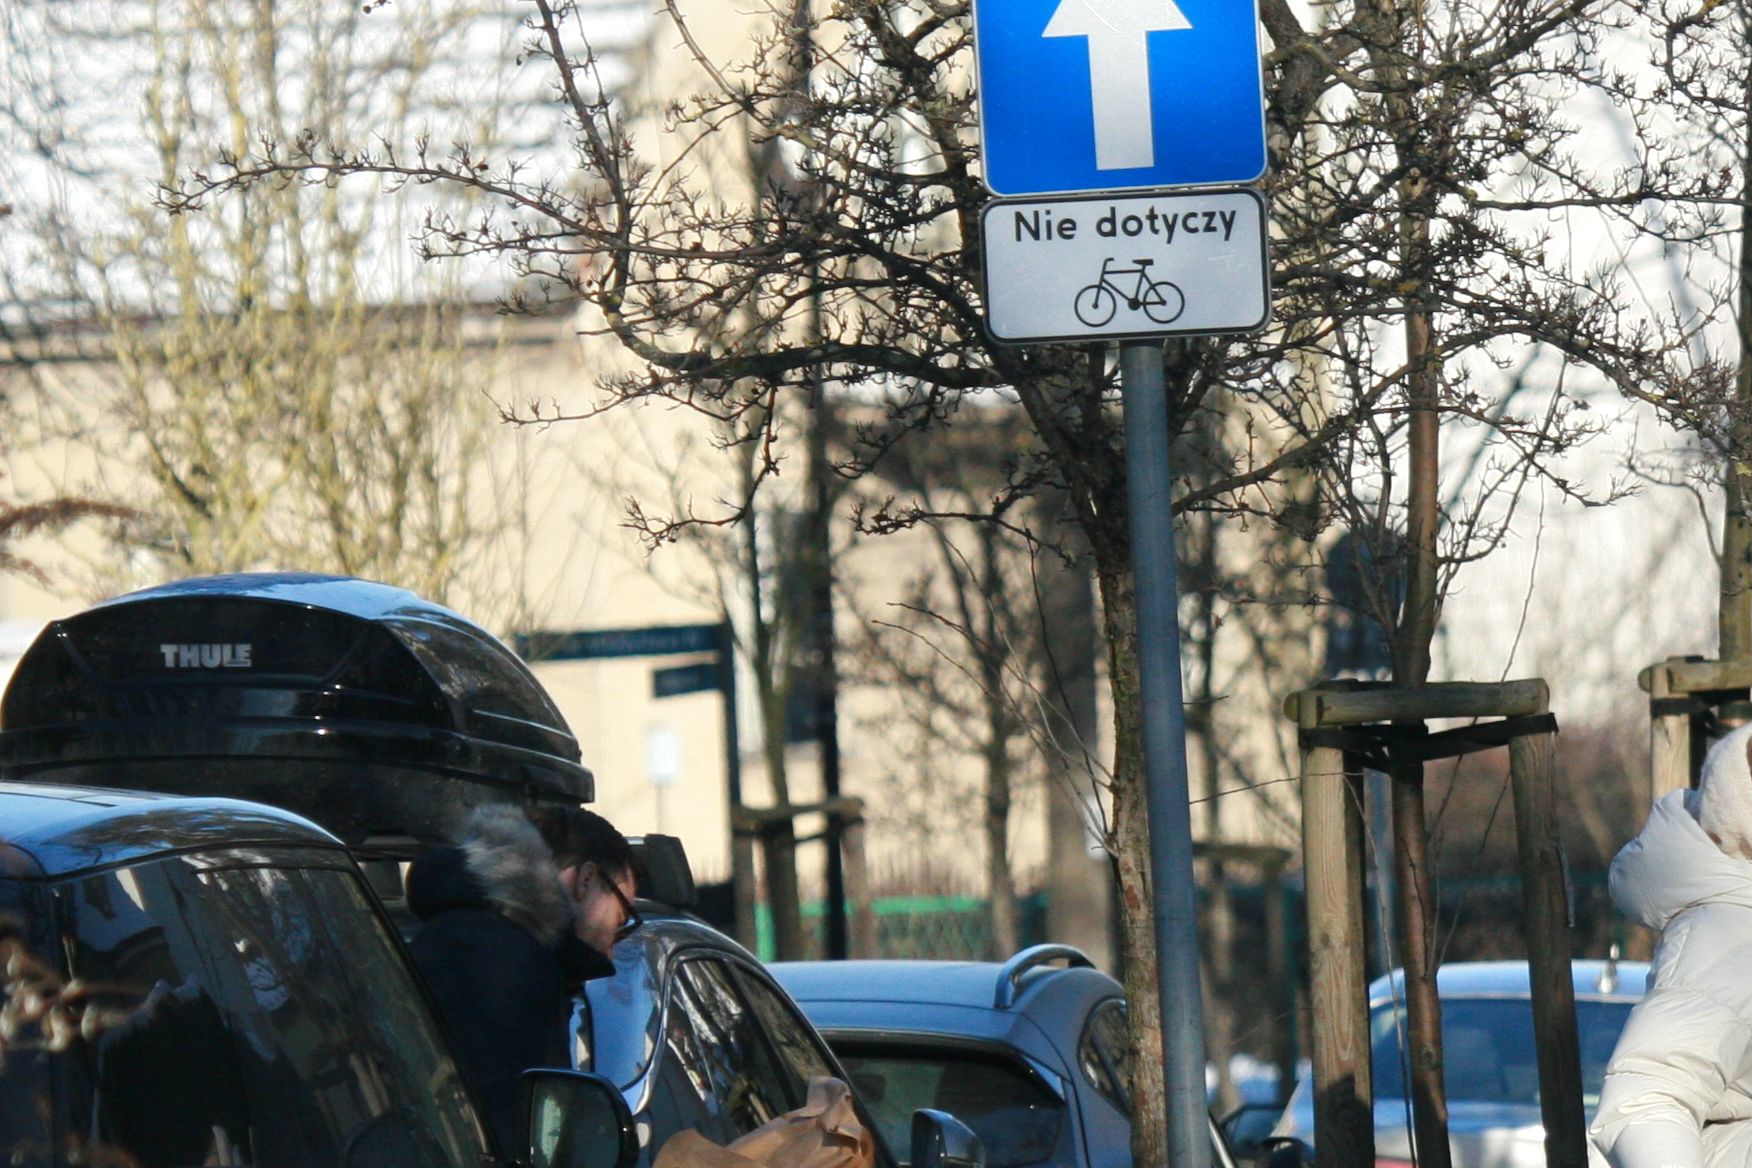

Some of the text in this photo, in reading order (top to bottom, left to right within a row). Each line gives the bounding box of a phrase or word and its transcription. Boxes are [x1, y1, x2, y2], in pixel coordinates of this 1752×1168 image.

[1014, 205, 1236, 245] Nie dotyczy
[159, 643, 252, 668] THULE
